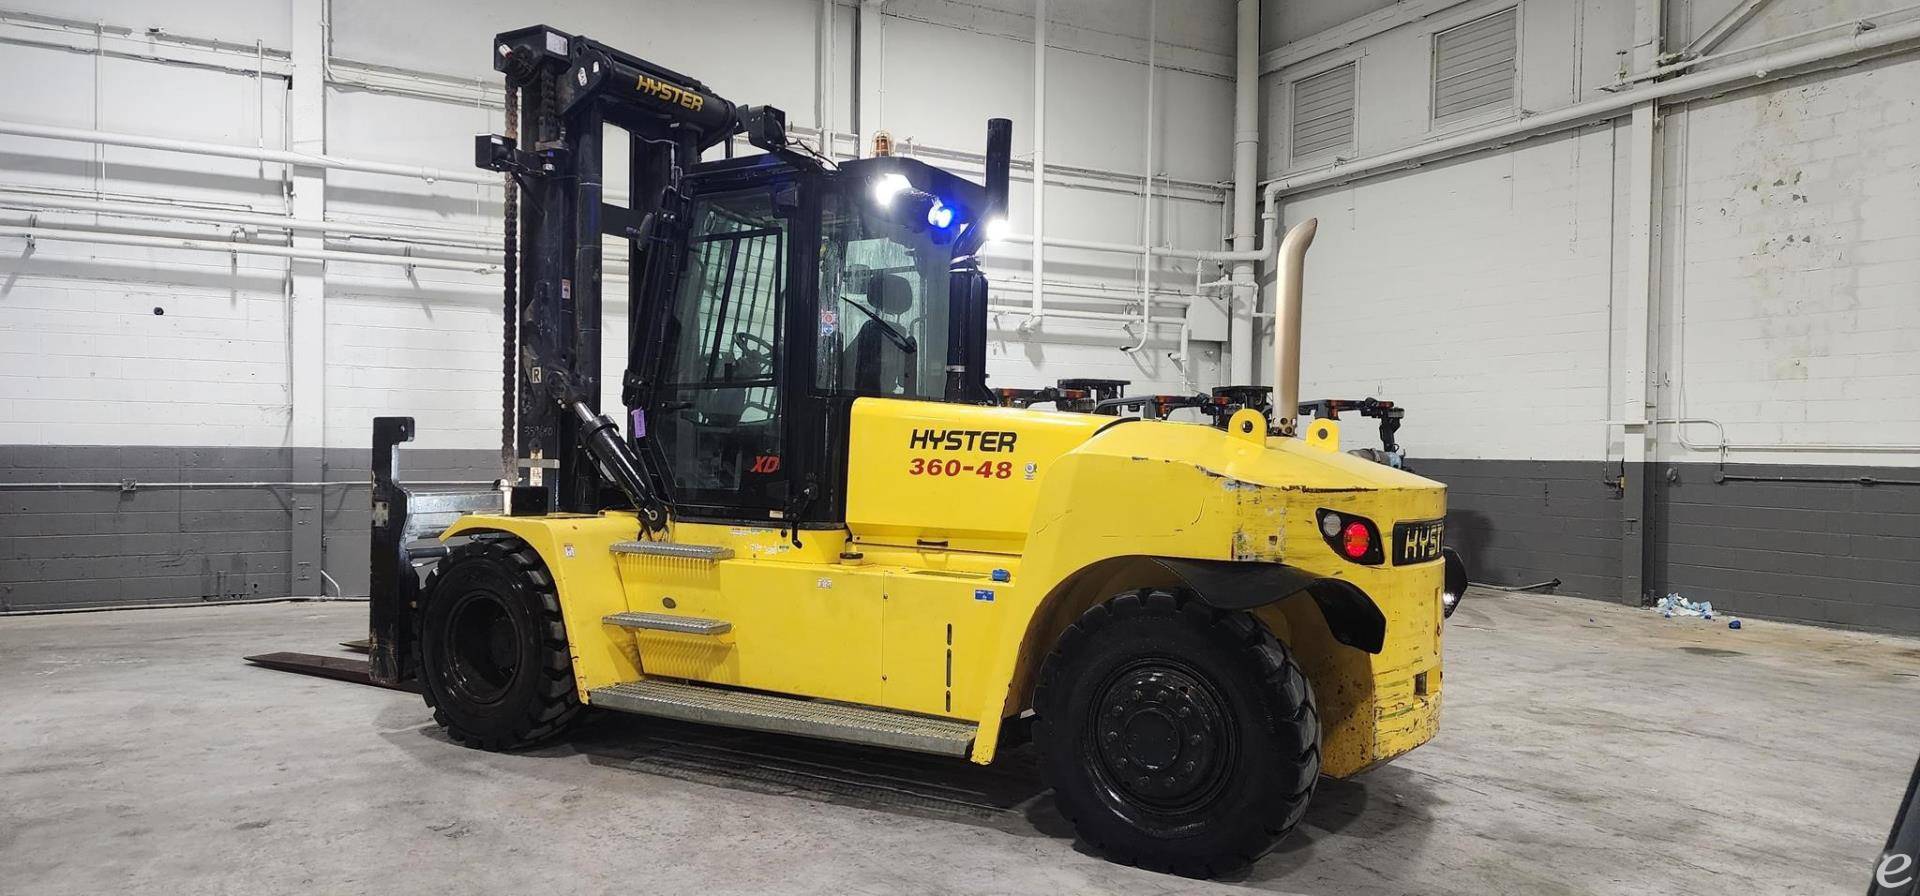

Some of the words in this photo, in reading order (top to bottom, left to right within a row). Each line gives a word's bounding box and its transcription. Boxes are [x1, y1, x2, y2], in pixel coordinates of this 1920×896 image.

[636, 75, 704, 111] HYSTER
[533, 368, 541, 382] R
[910, 429, 1017, 453] HYSTER
[750, 456, 779, 473] XD
[909, 458, 1013, 480] 360-48
